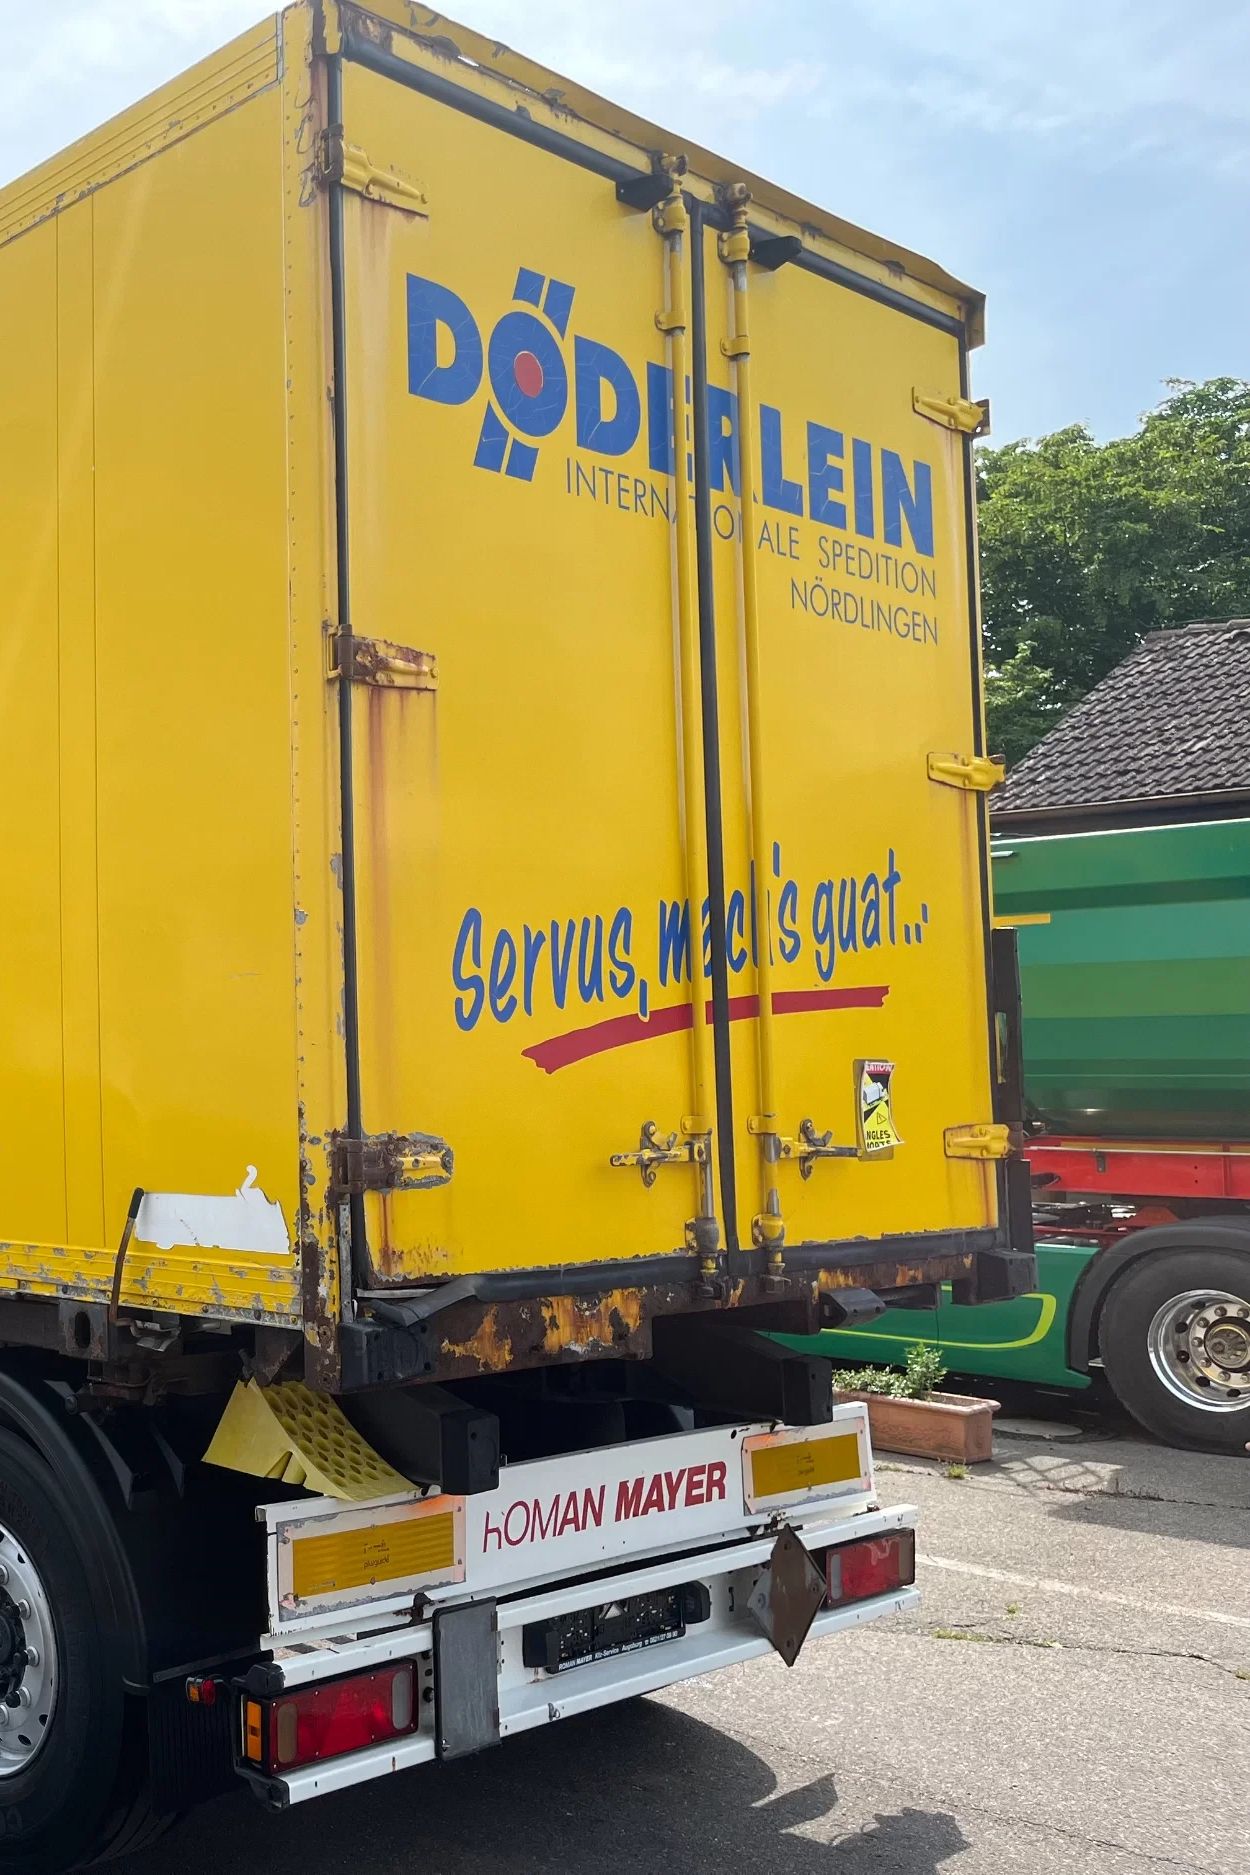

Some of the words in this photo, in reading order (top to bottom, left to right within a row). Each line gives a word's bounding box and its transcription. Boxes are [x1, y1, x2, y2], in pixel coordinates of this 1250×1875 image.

[406, 267, 935, 557] DÖDERLEIN
[566, 457, 800, 560] INTERNOALE
[819, 534, 937, 599] SPEDITION
[791, 576, 938, 645] NÖRDLINGEN
[452, 907, 648, 1031] Servus,
[866, 1130, 890, 1140] NGLES
[615, 1460, 727, 1523] MAYER
